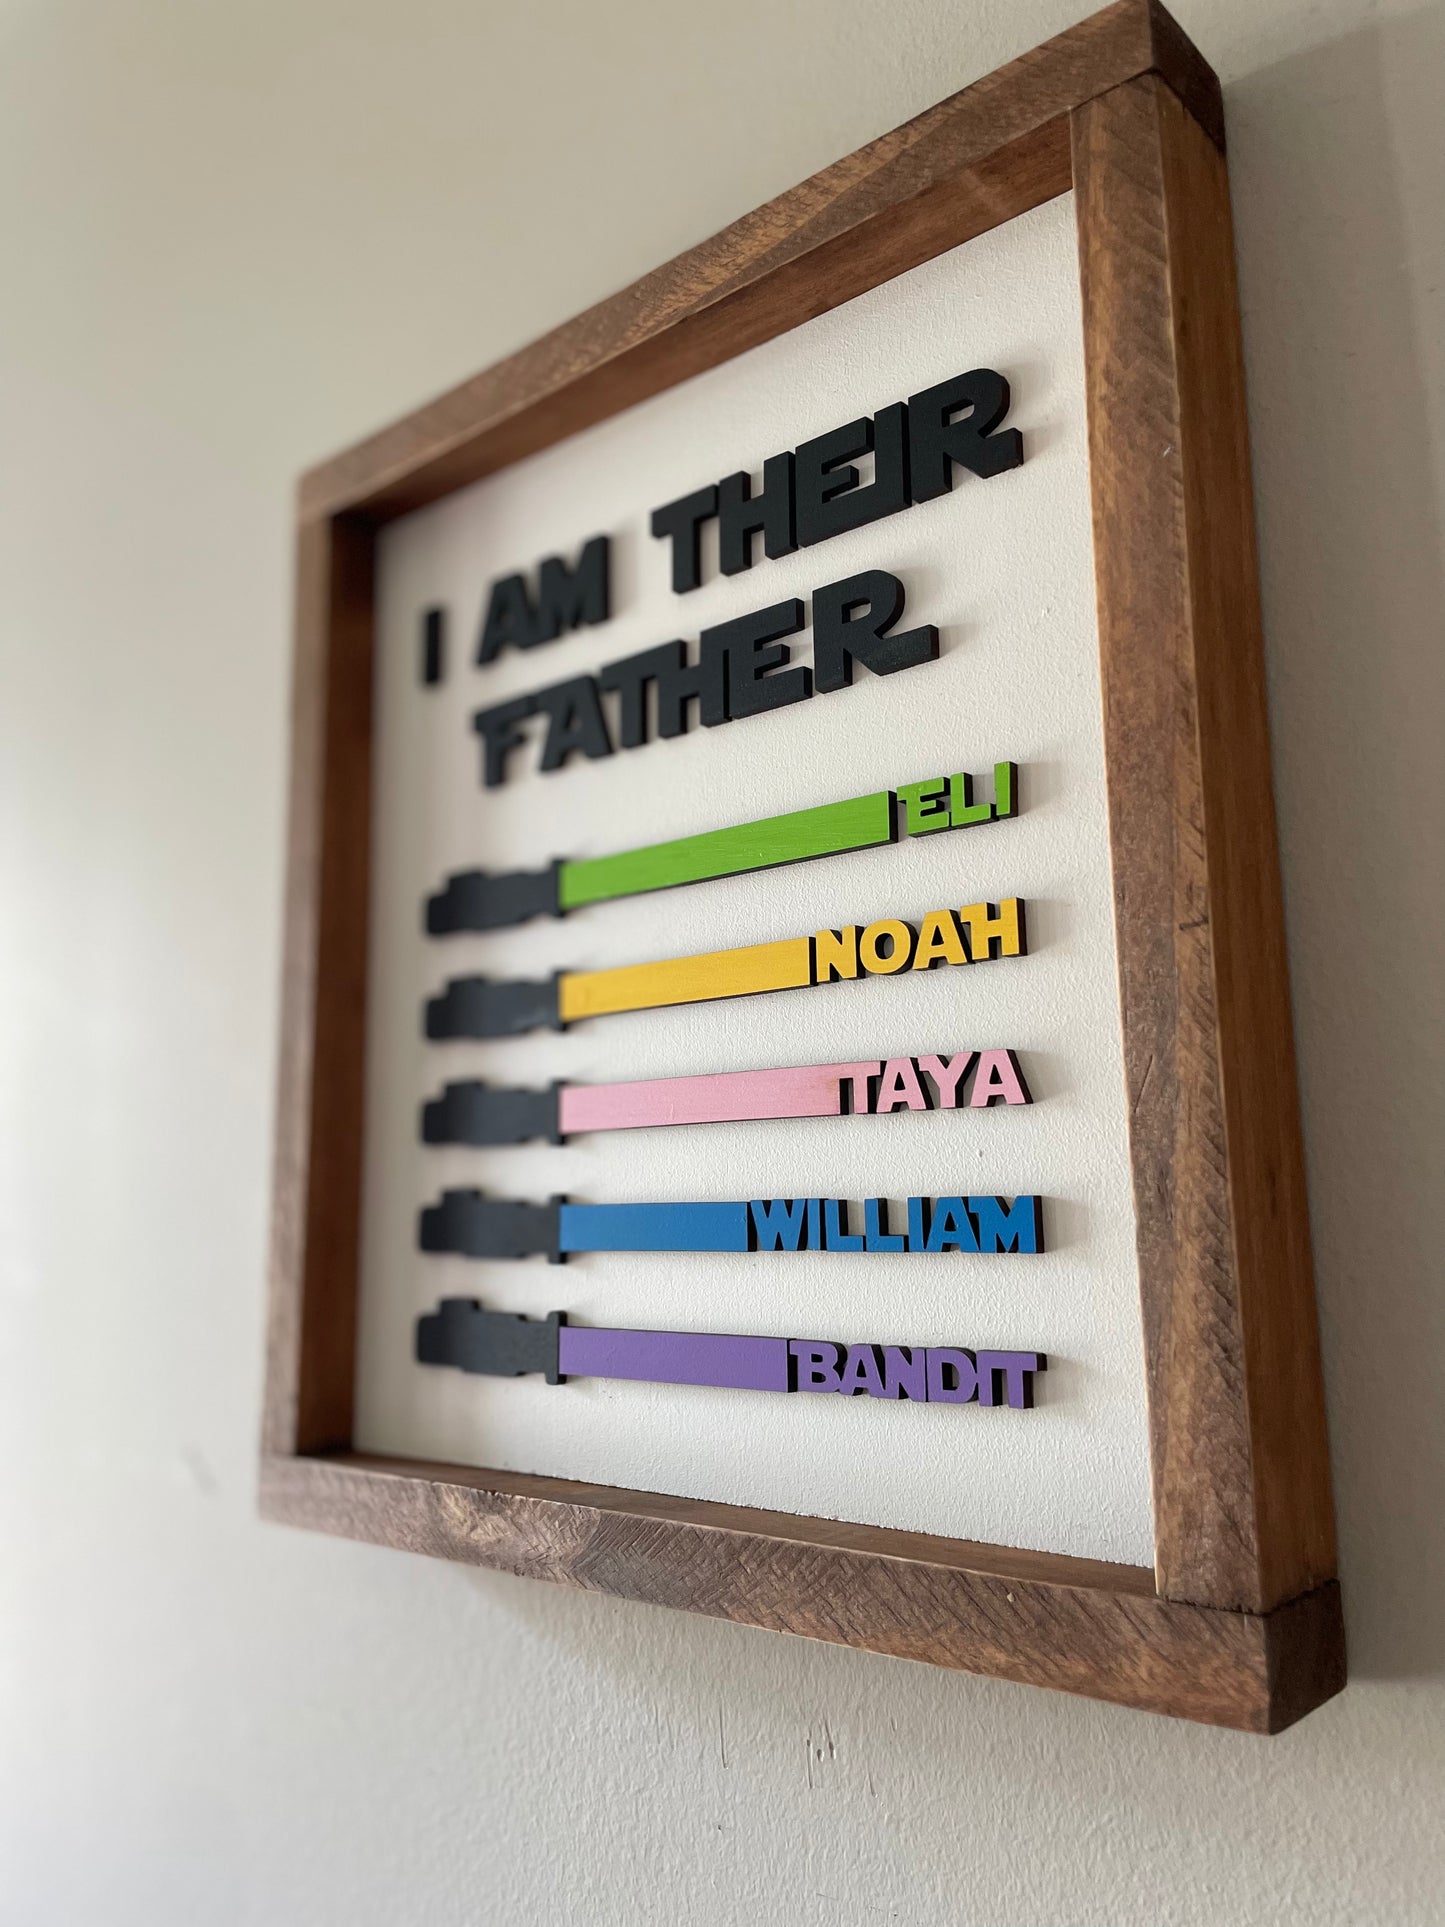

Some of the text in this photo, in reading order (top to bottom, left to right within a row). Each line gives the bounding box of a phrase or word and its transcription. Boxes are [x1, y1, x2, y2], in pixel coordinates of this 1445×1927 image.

[423, 367, 1024, 686] I AM THEIR
[472, 568, 940, 788] FATHER
[896, 760, 1018, 838] ELI
[815, 896, 1028, 984] NOAH
[840, 1048, 1034, 1115] TAYA
[750, 1194, 1045, 1254] WILLIAM
[789, 1338, 1048, 1410] BANDIT
